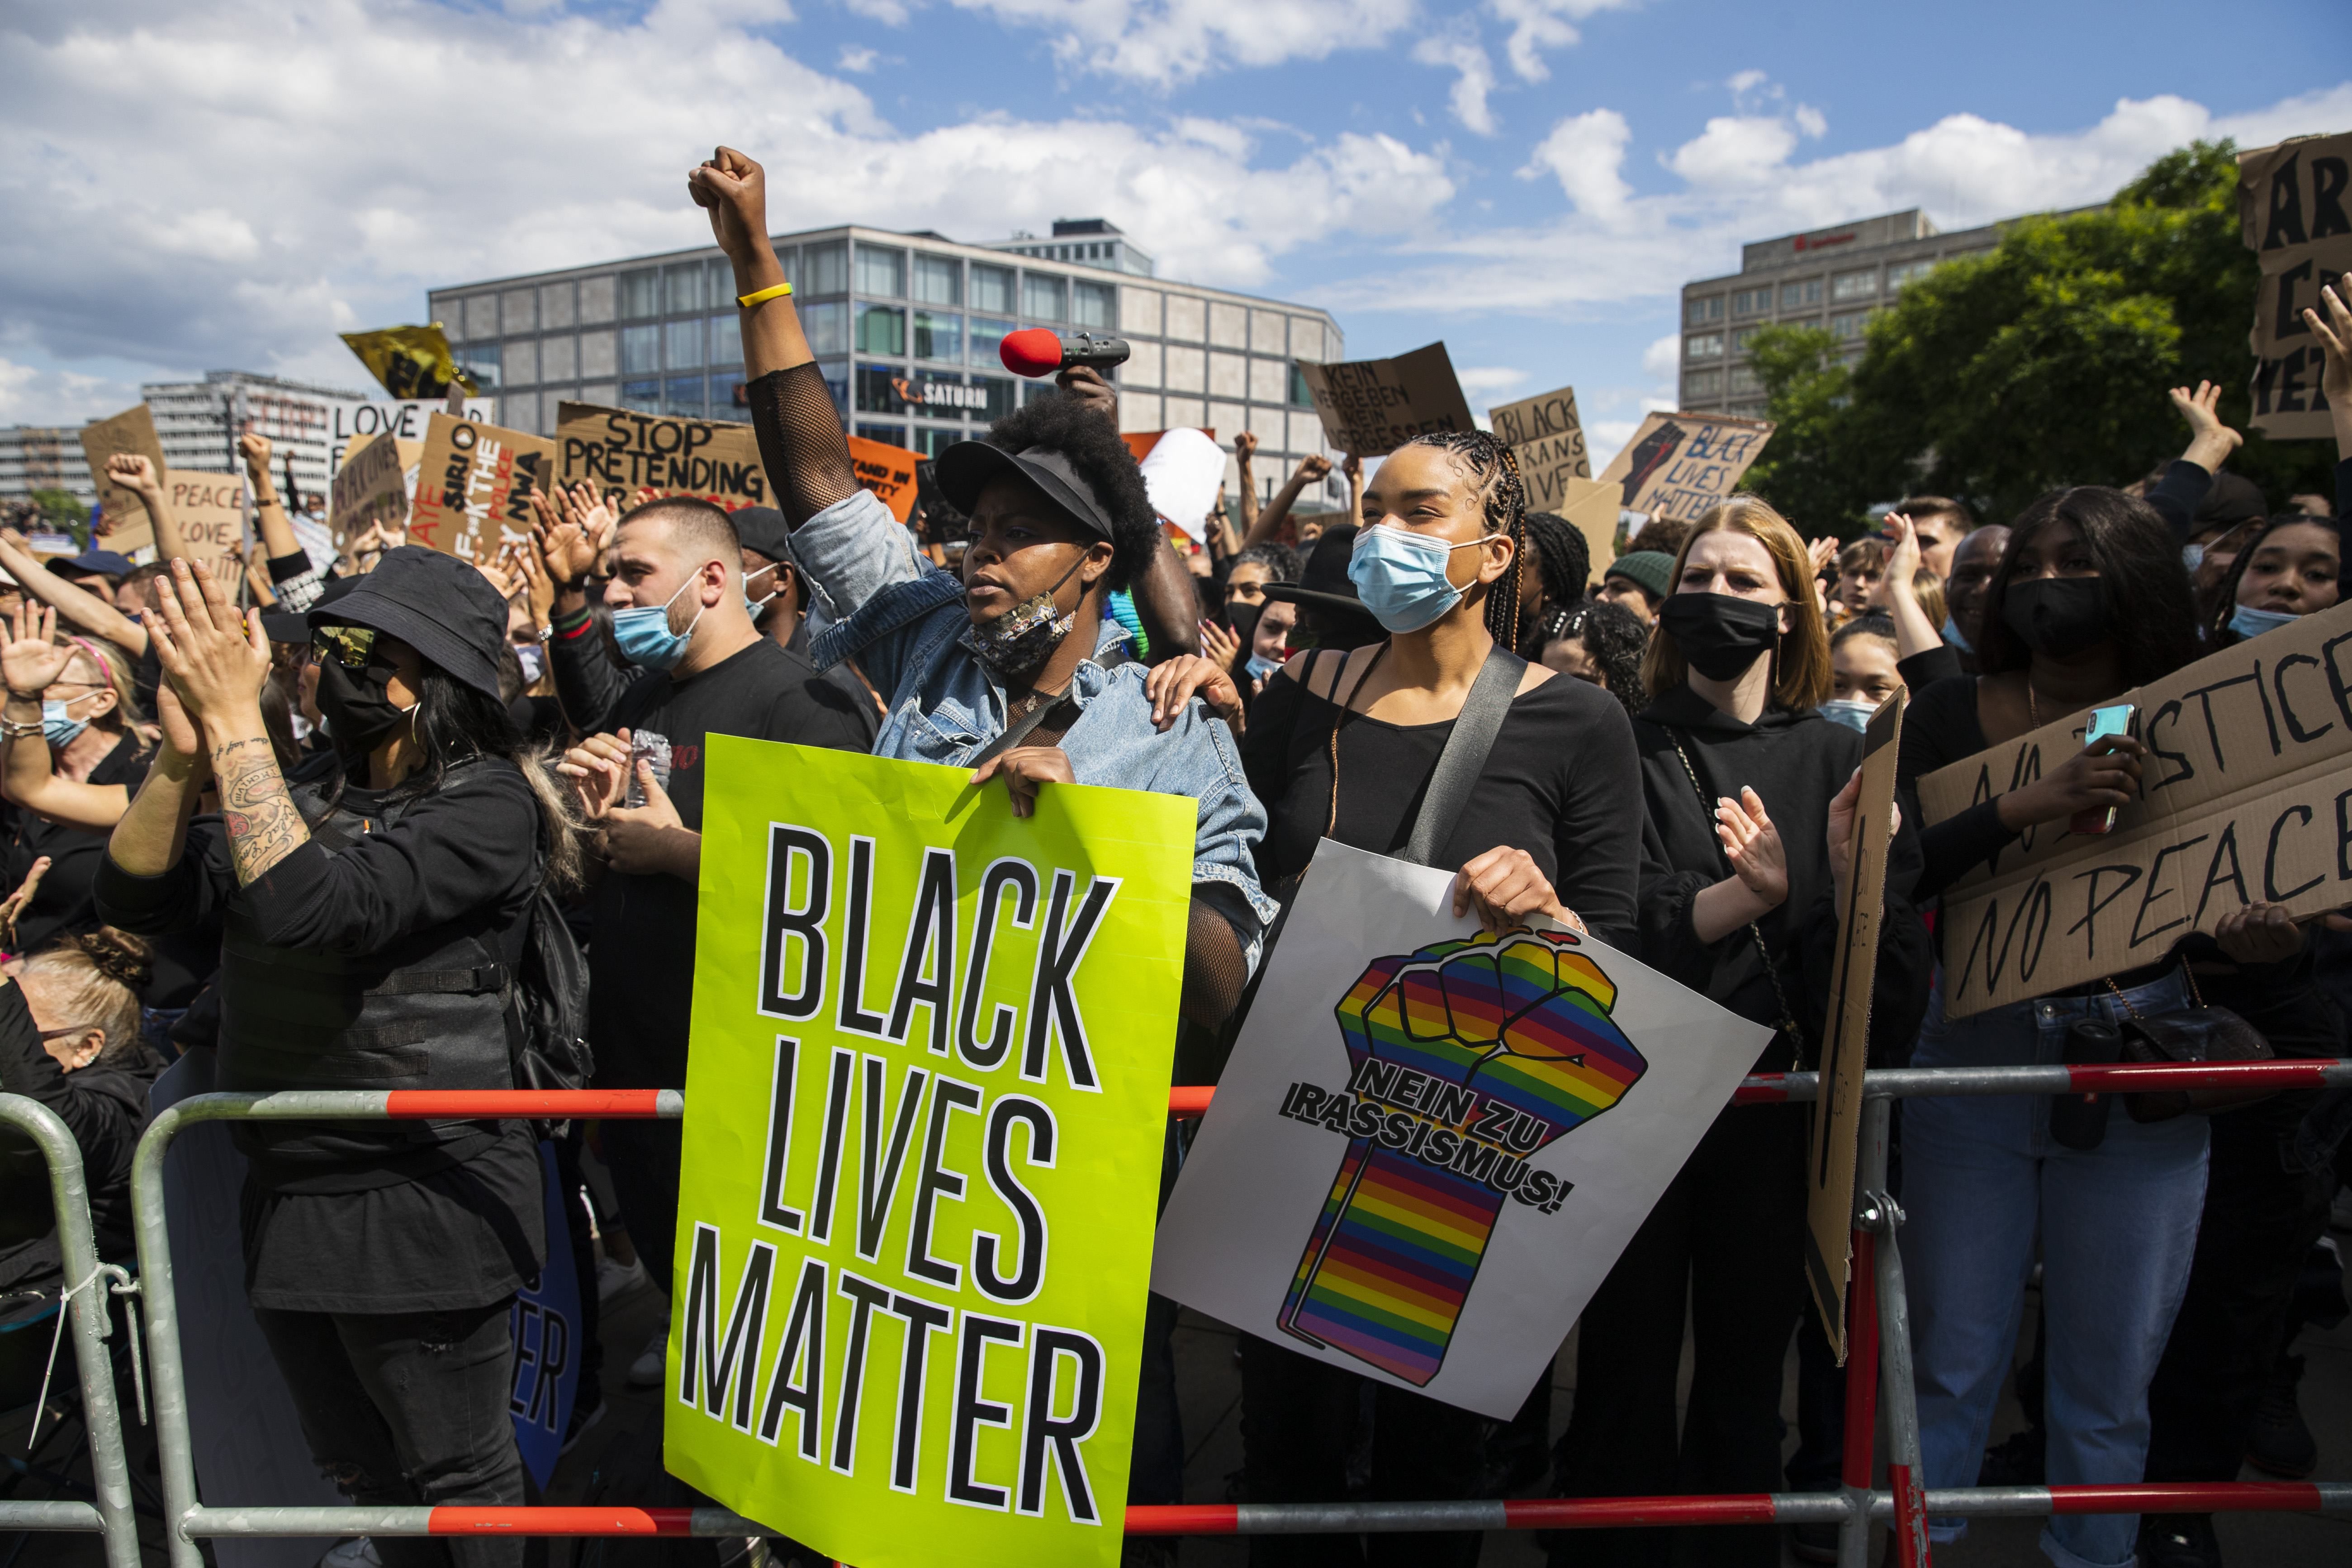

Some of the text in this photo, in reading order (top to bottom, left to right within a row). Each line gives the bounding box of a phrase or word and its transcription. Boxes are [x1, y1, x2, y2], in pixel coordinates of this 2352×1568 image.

[923, 383, 988, 409] SATURN
[1323, 362, 1380, 390] KEIN
[337, 405, 418, 439] LOVE
[605, 413, 712, 457] STOP
[1343, 409, 1389, 428] KEIN
[1494, 396, 1579, 446] BLACK
[1686, 425, 1759, 463] BLACK
[467, 436, 501, 496] THE
[565, 437, 763, 503] PRETENDING
[1515, 433, 1584, 469] RANS
[1665, 460, 1731, 493] LIVES
[173, 483, 243, 509] PEACE
[443, 453, 469, 512] SIRI
[488, 447, 514, 521] POLICE
[507, 451, 542, 522] NWA
[180, 521, 232, 545] LOVE
[410, 482, 445, 547] AYE
[1957, 787, 2352, 1001] NO PEACE
[757, 821, 1124, 1094] BLACK
[1351, 1057, 1550, 1154] NEIN ZU
[757, 1034, 1058, 1305] LIVES
[1280, 1081, 1575, 1215] RASSISMUS!
[678, 1221, 1106, 1526] MATTER
